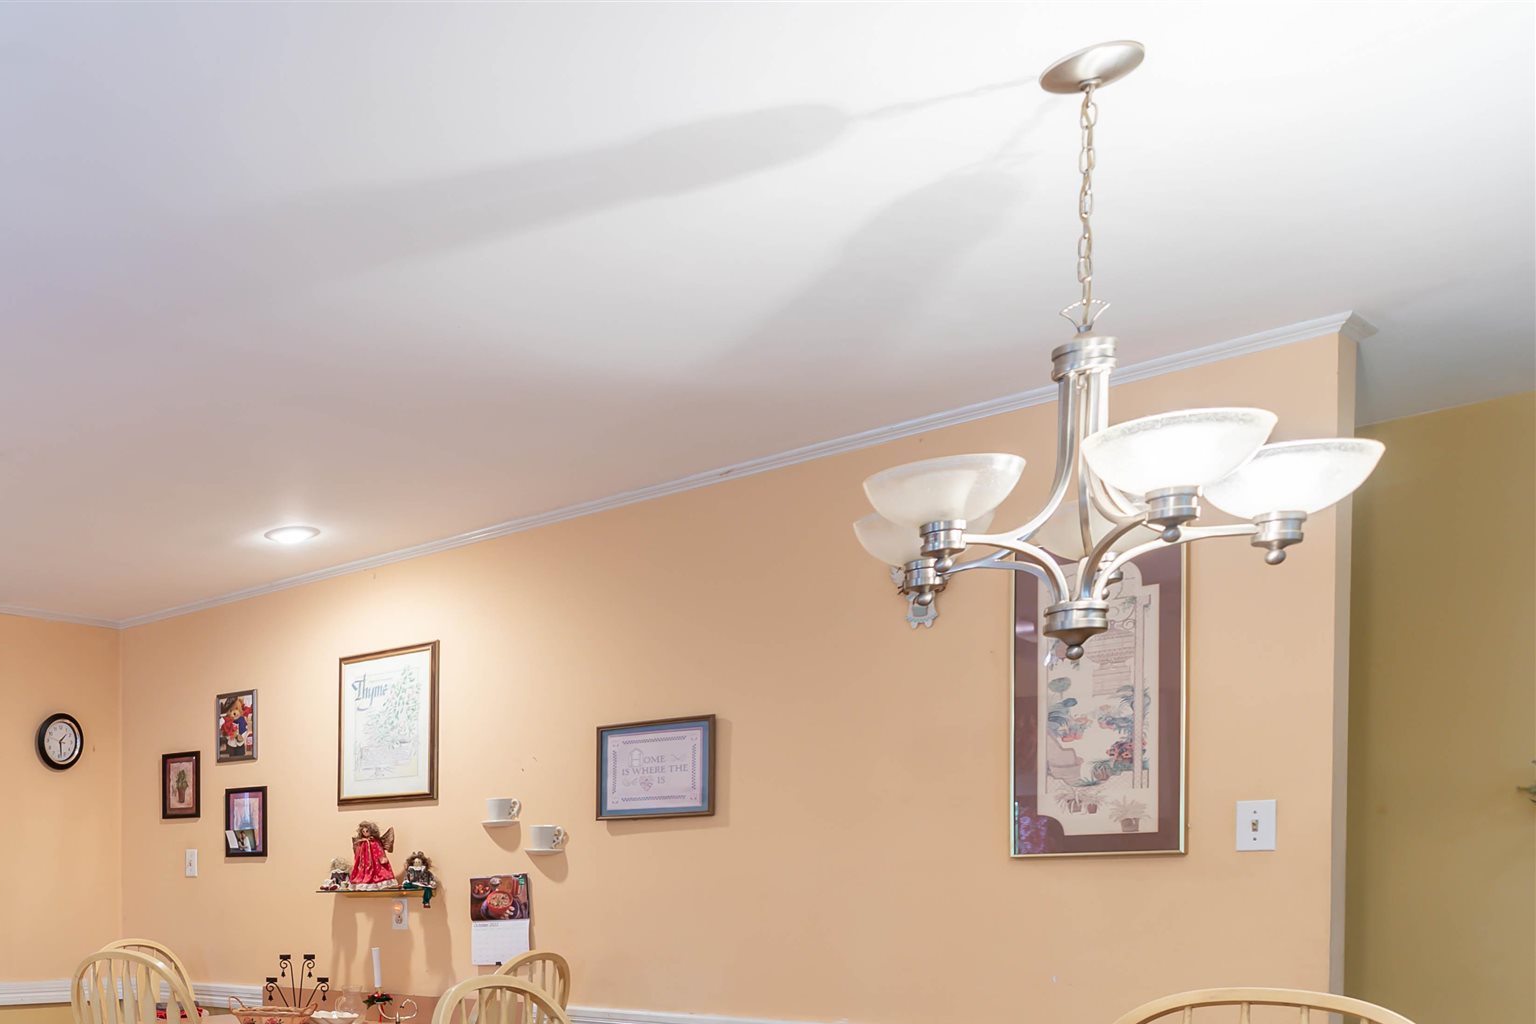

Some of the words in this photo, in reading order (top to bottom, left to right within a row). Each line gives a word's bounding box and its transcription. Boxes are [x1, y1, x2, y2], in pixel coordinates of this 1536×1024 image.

[352, 673, 388, 707] Thyme
[622, 767, 631, 776] IS
[632, 765, 666, 775] WHERE
[669, 763, 689, 773] THE
[657, 775, 666, 784] IS
